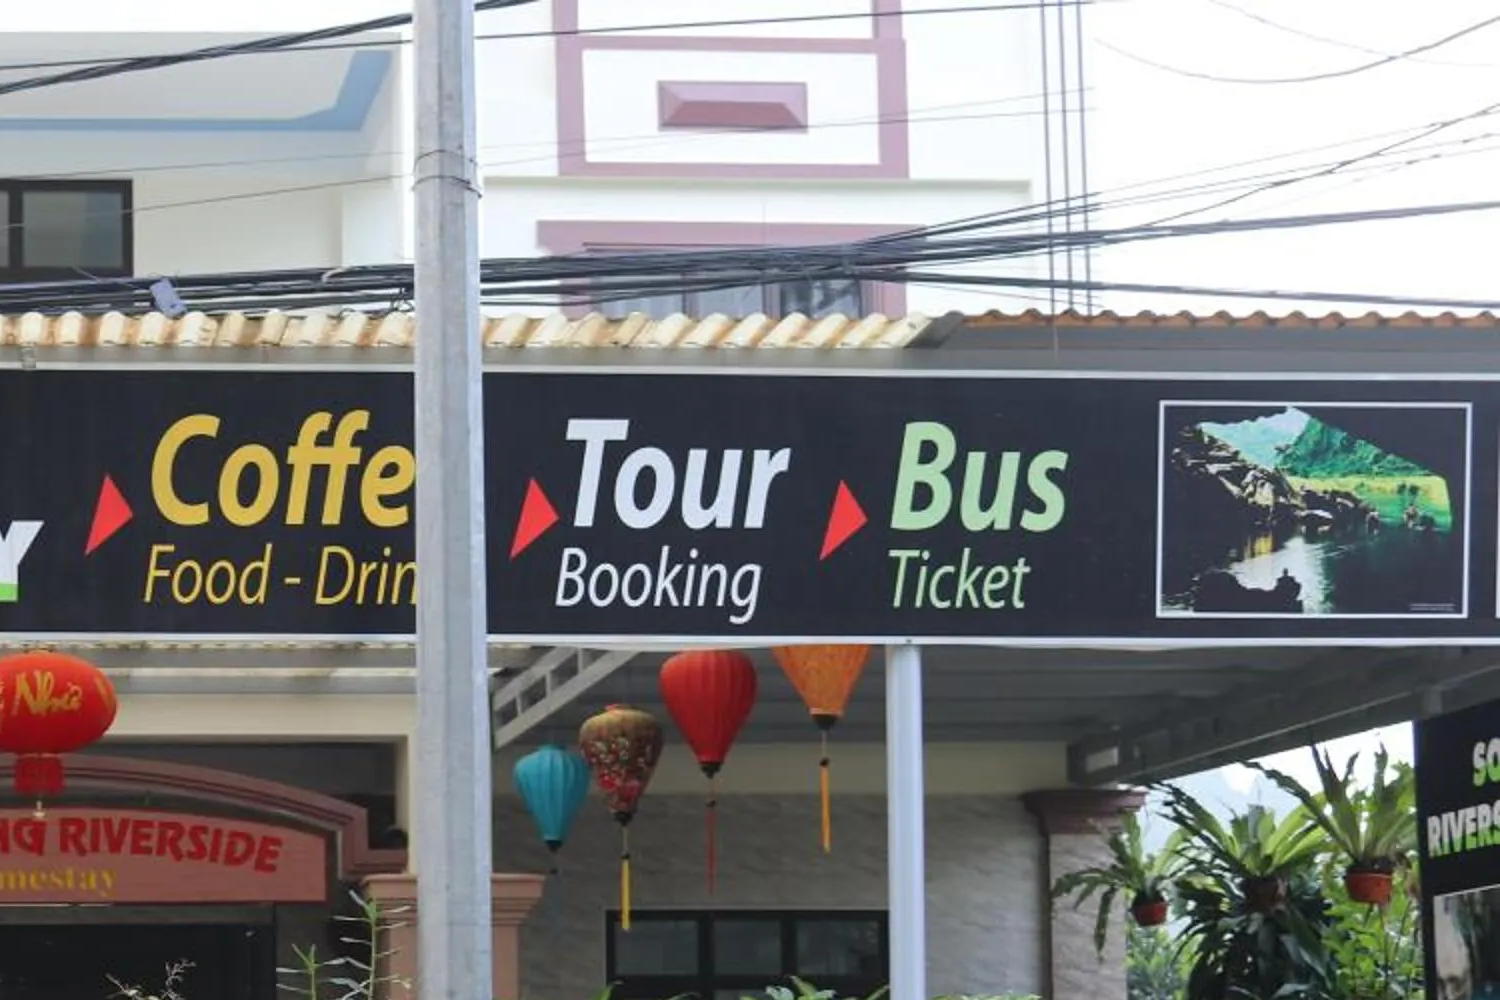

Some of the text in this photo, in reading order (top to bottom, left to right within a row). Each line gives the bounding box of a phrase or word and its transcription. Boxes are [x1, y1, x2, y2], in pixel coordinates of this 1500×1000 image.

[151, 409, 416, 528] Coffe
[565, 418, 793, 531] Tour
[890, 421, 1070, 533] Bus
[143, 543, 274, 606] Food
[315, 545, 417, 606] Drin
[555, 545, 762, 625] Booking
[888, 548, 1032, 610] Ticket
[59, 816, 284, 874] RIVERSIDE
